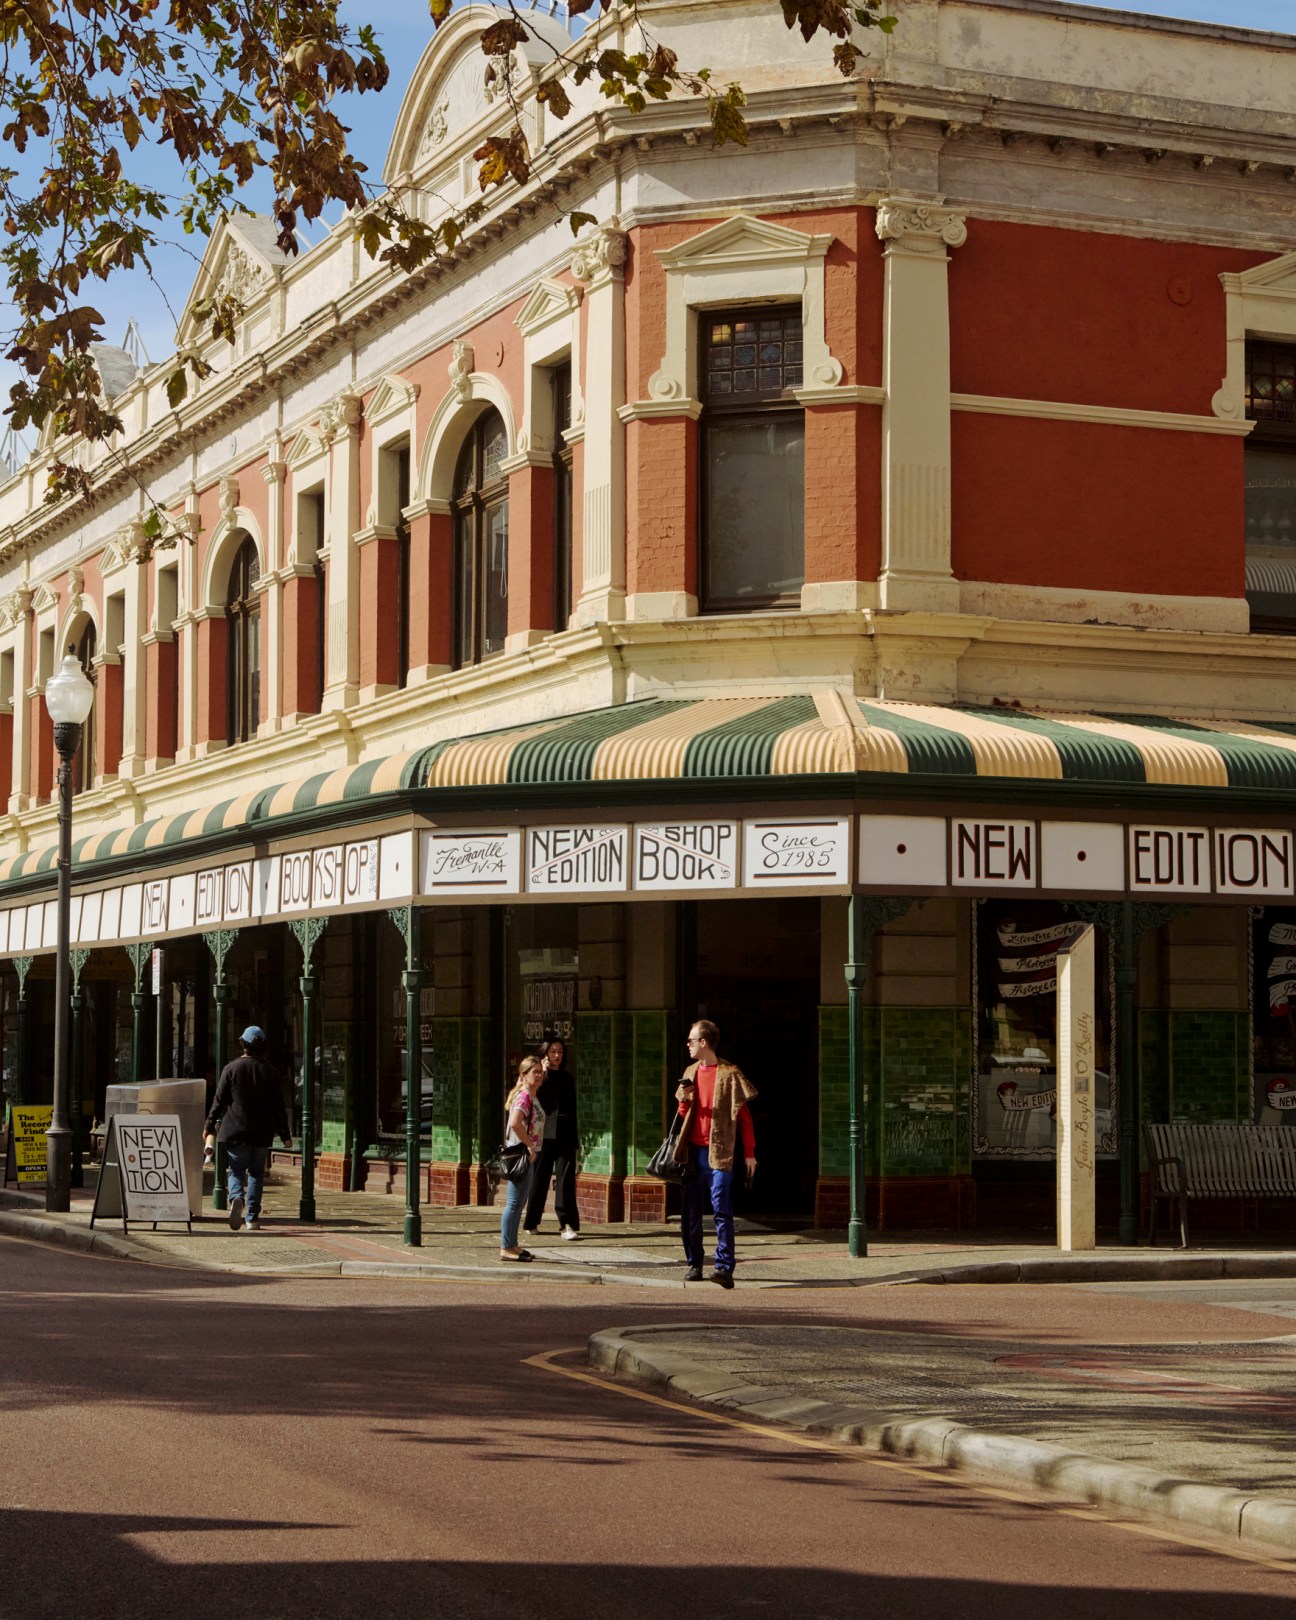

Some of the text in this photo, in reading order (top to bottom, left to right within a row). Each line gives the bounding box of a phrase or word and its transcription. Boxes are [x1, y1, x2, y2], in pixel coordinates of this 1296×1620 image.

[436, 840, 507, 875] Fremantle
[531, 829, 594, 870] NEW
[547, 835, 624, 884] EDITION
[639, 835, 716, 882] BOOK
[664, 825, 732, 861] SHOP
[761, 831, 820, 868] Since
[781, 840, 836, 868] 1985
[957, 824, 1290, 889] NEW EDITION
[143, 883, 167, 930] NEW
[197, 866, 251, 920] EDITION
[283, 844, 369, 906] BOOKSHOP
[420, 1023, 433, 1040] EEK
[1010, 1090, 1057, 1108] NEW EDITIO
[123, 1128, 174, 1149] NEW
[139, 1150, 175, 1169] EDI
[128, 1170, 180, 1191] TION
